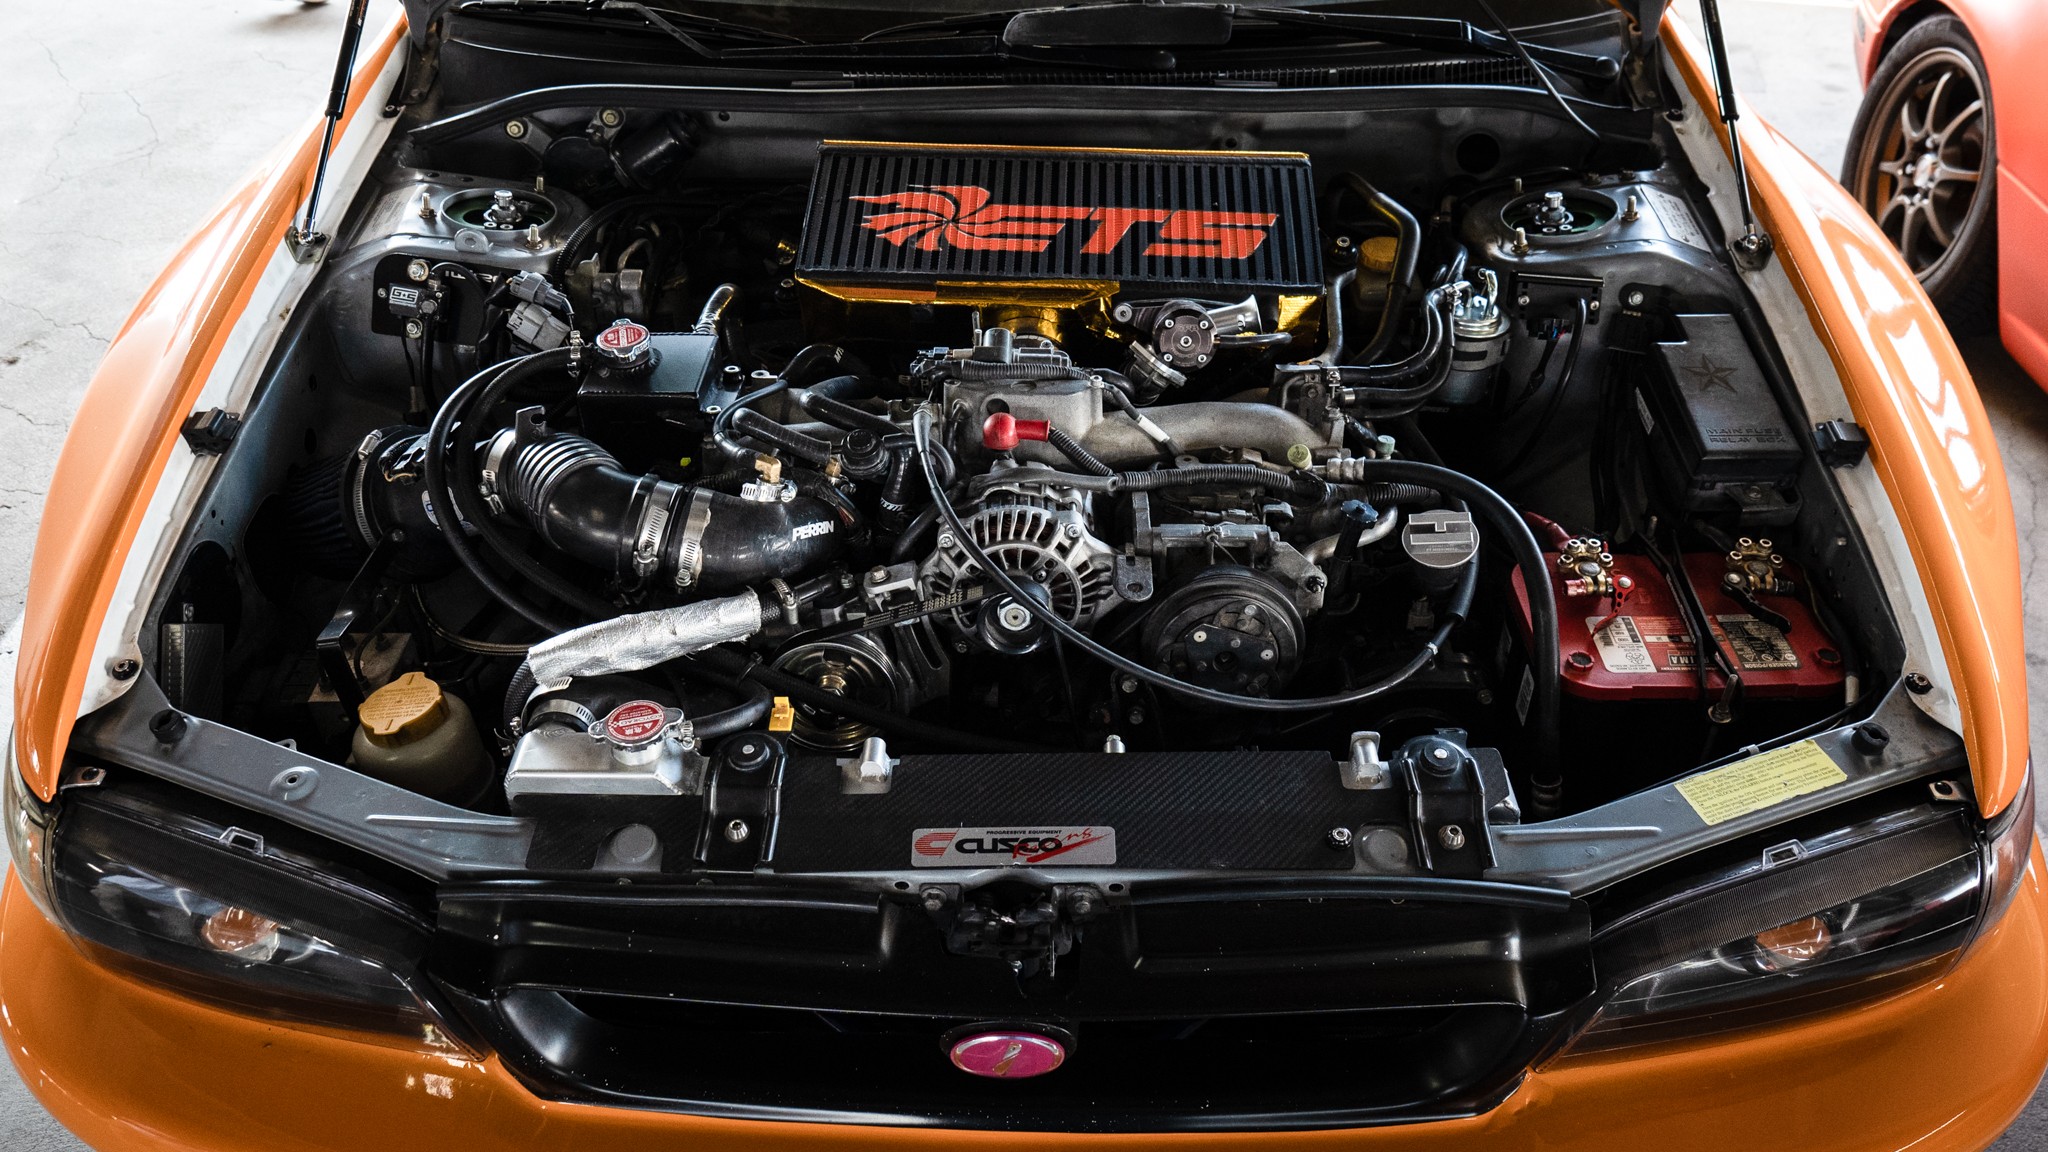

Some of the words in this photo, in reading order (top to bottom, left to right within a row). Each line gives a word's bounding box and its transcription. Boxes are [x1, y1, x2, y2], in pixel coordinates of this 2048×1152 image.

[940, 202, 1279, 259] ETS
[792, 520, 834, 542] PERRIN
[621, 713, 663, 726] KOYORAD
[954, 837, 1063, 854] CUSCO
